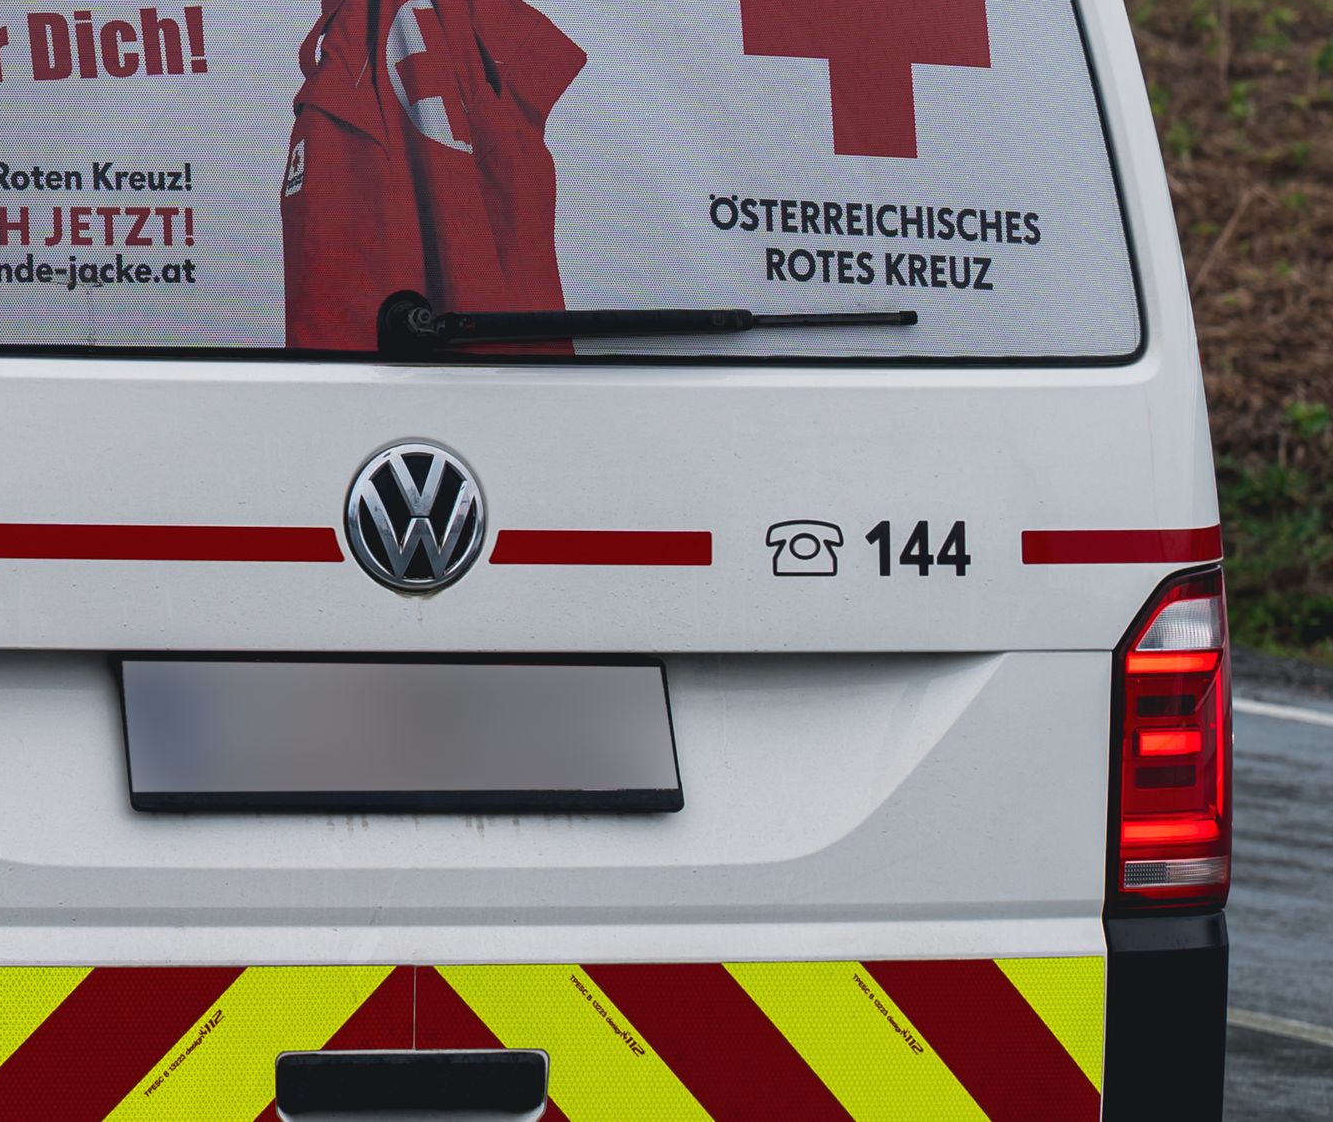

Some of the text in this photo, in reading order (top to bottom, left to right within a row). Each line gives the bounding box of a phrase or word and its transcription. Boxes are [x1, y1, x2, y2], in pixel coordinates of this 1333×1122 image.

[27, 6, 209, 81] Dich!
[92, 162, 193, 192] Kreuz!
[44, 206, 196, 247] JETZT!
[709, 194, 1042, 246] ÖSTERREICHISCHES
[765, 247, 994, 290] ROTES KREUZ
[864, 520, 972, 576] 144
